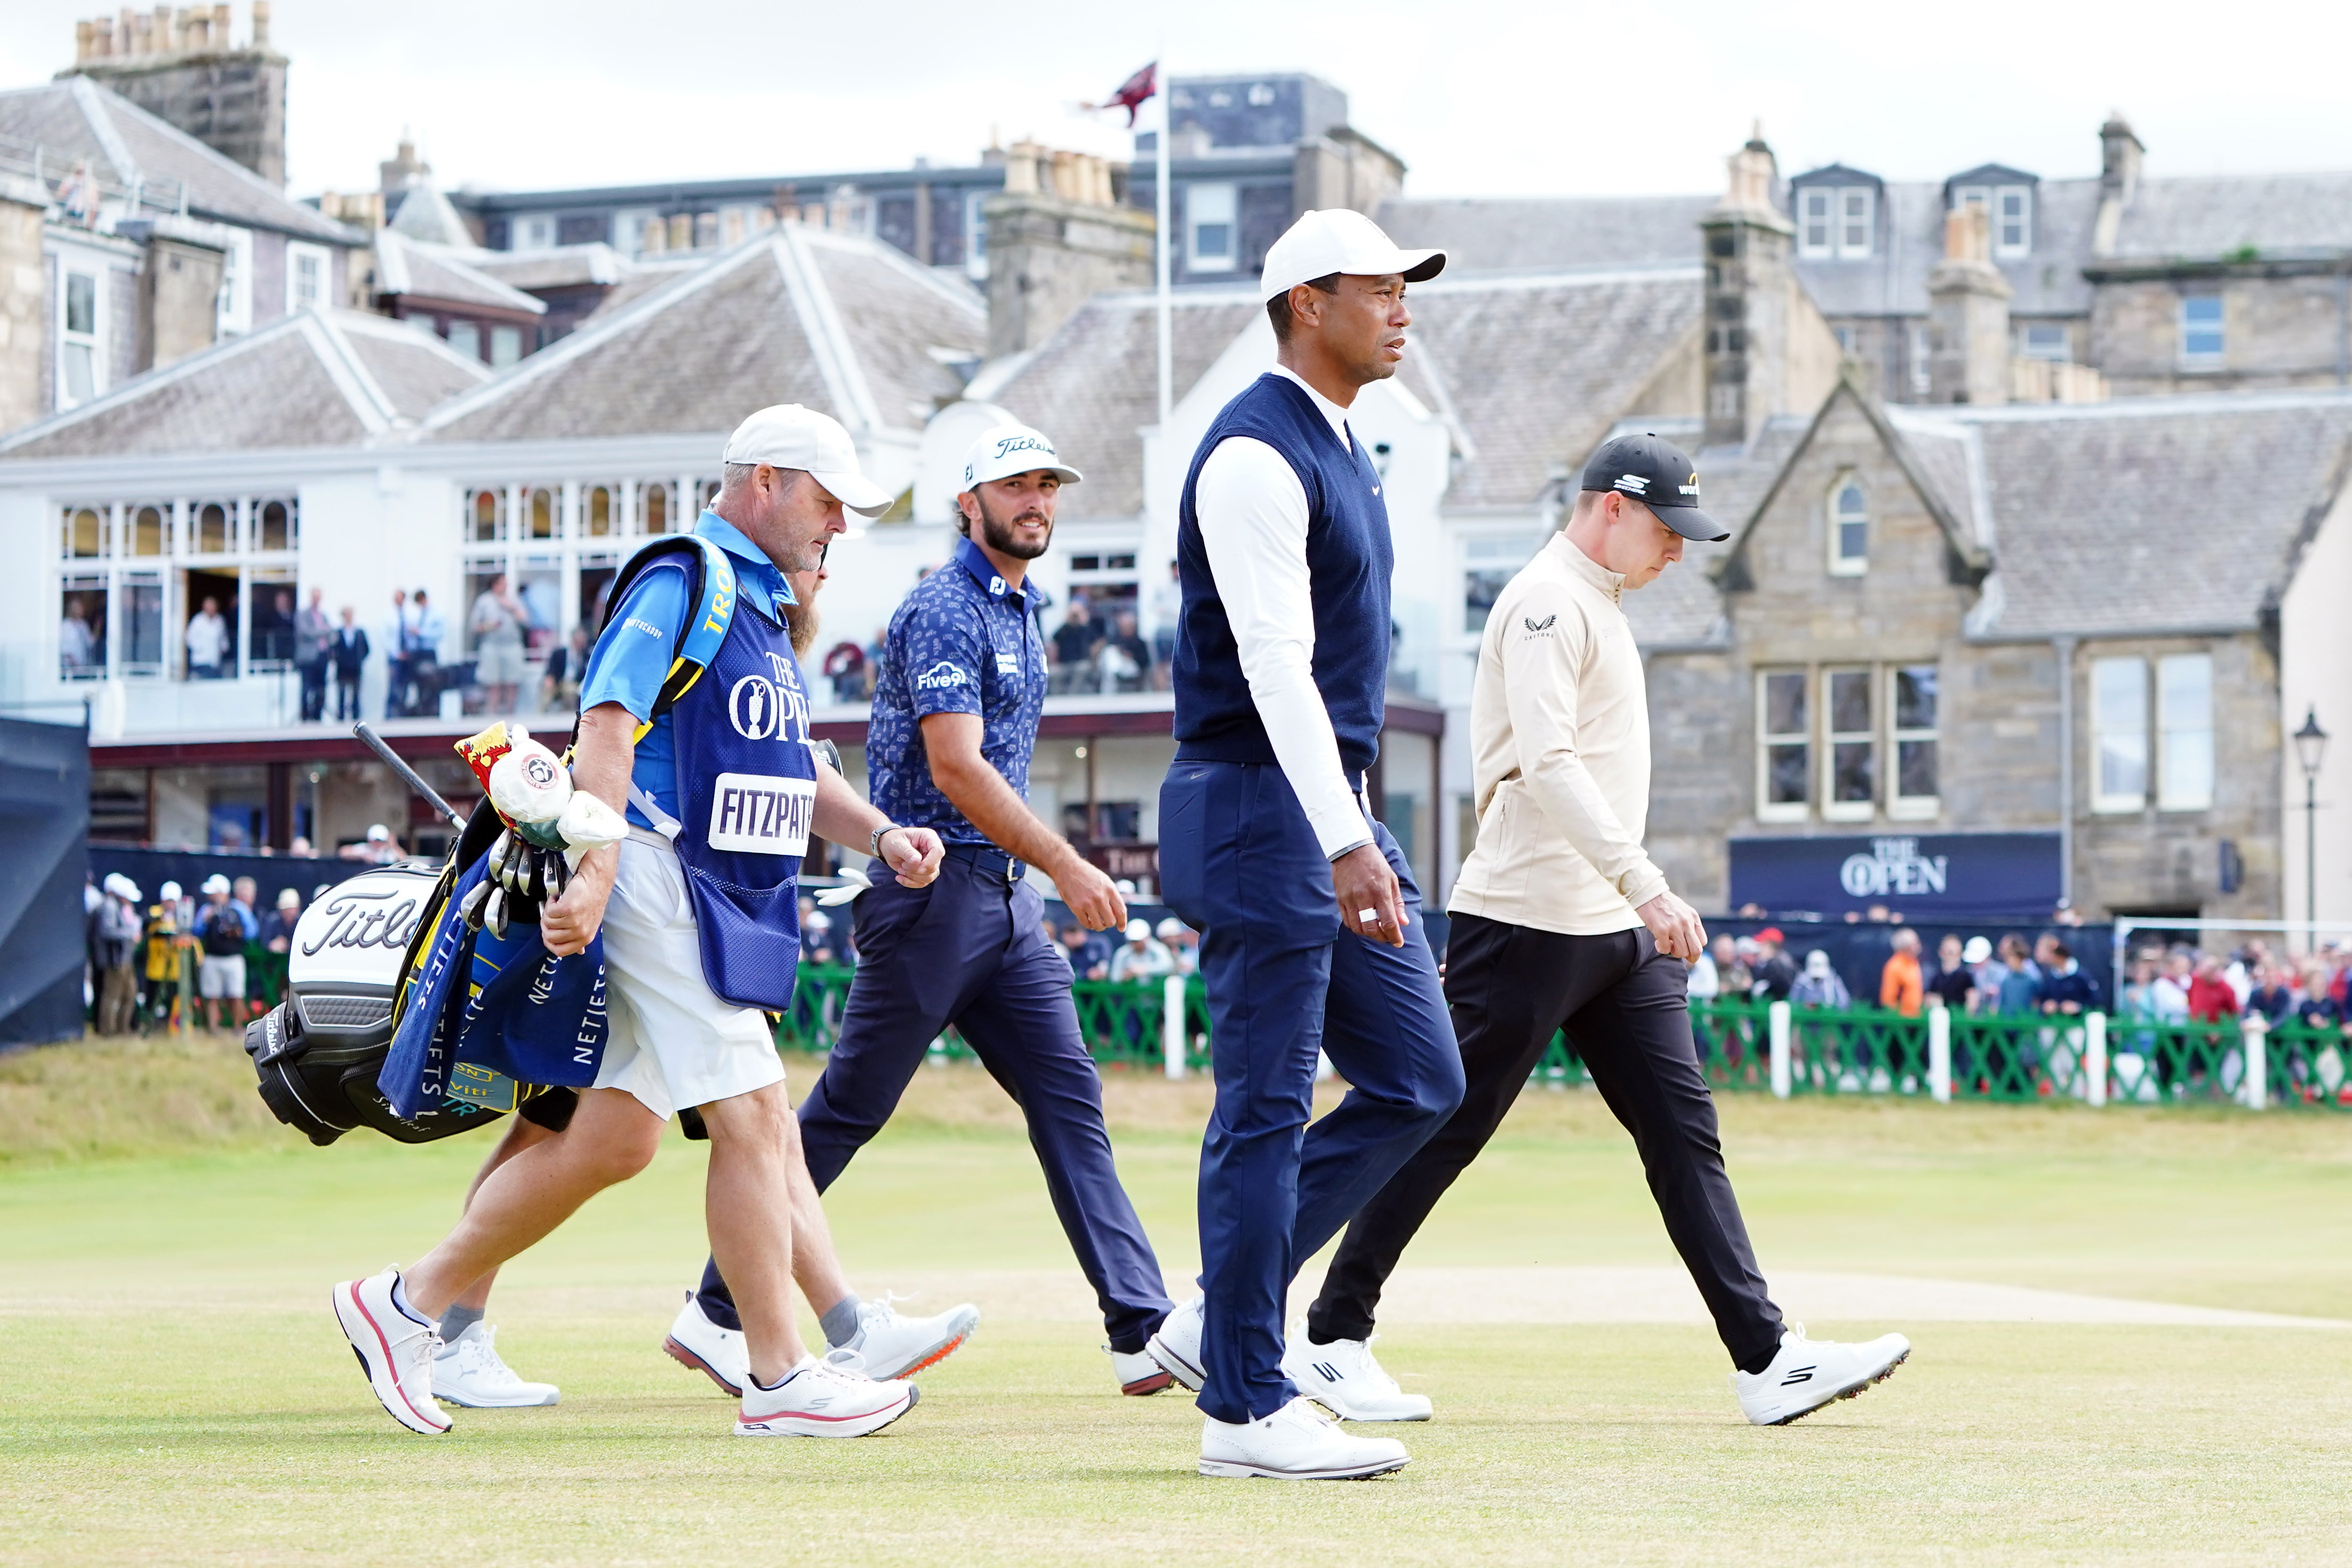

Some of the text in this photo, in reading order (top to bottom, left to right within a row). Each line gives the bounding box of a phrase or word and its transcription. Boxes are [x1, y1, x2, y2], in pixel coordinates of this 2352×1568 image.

[989, 575, 1006, 596] FJ
[1525, 633, 1554, 641] CASTORE
[765, 651, 800, 690] THE
[918, 672, 961, 690] Five9
[1870, 838, 1919, 861] THE
[1841, 853, 1948, 898] OPEN
